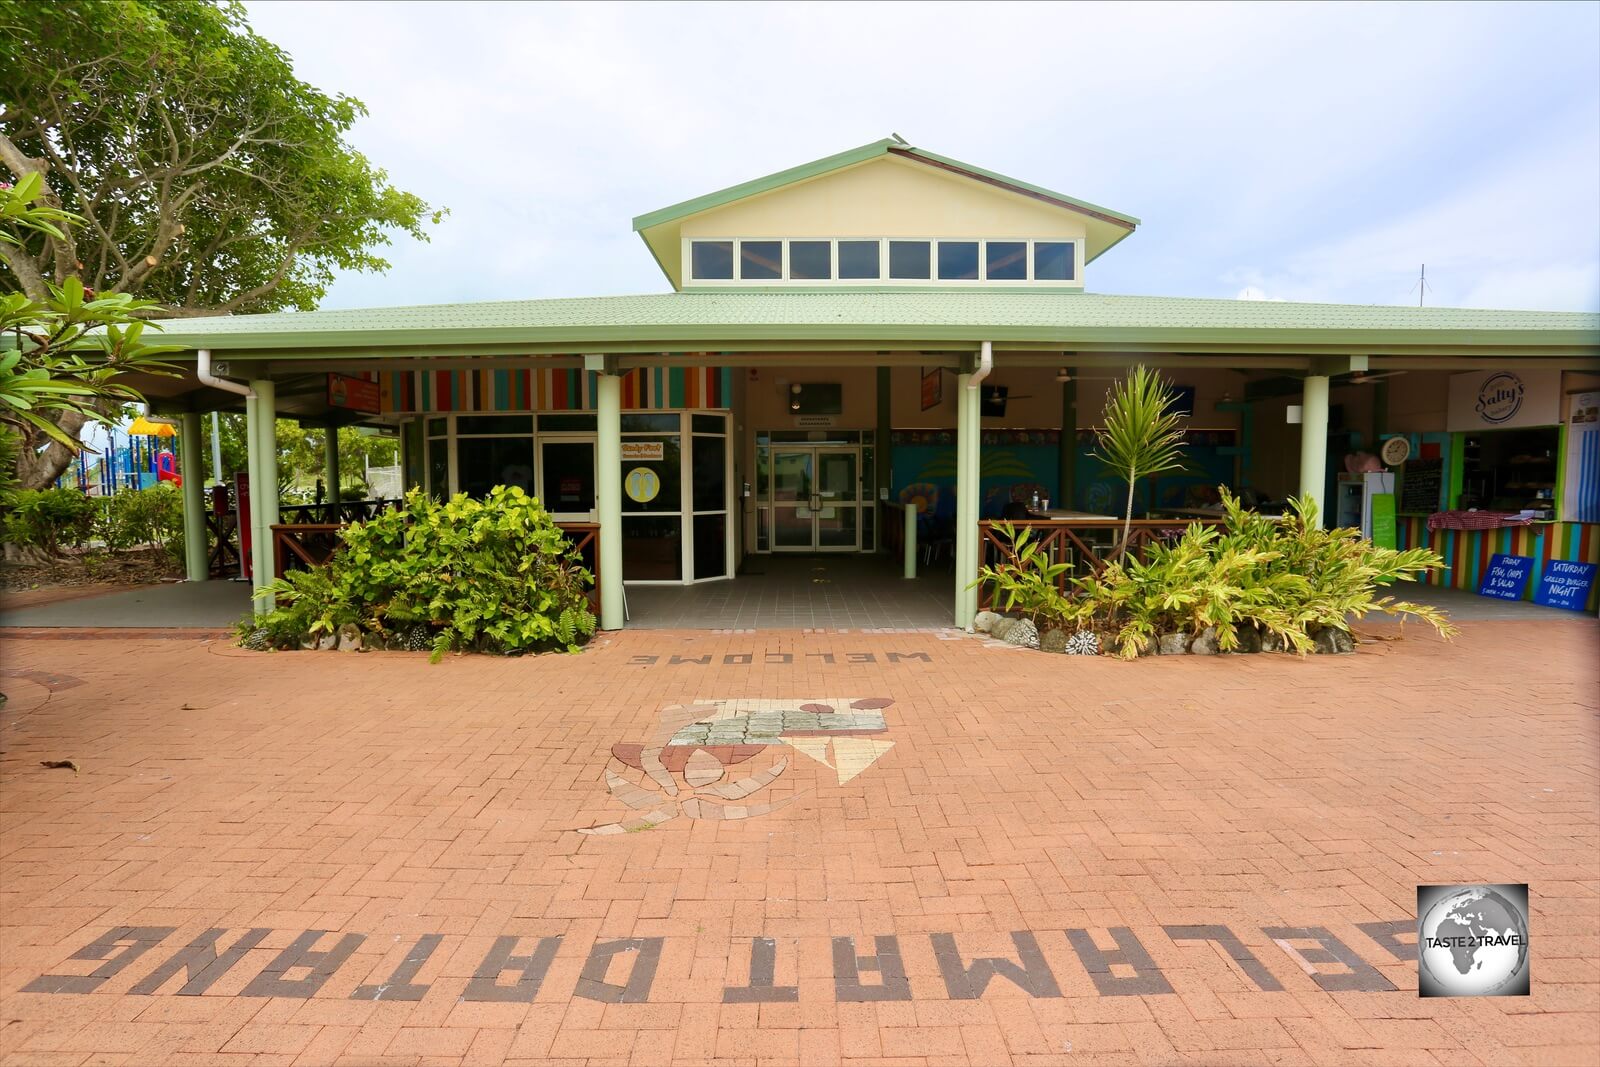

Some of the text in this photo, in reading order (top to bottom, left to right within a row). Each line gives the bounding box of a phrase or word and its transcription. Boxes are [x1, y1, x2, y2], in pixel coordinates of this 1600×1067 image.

[1475, 383, 1524, 412] Salty's
[1502, 557, 1521, 566] FRIDAY
[1506, 568, 1523, 580] CHIPS
[1553, 562, 1589, 575] SATURDAY
[1497, 577, 1515, 588] SALAD
[1565, 577, 1589, 588] BURGER
[1548, 583, 1580, 597] NIGHT
[626, 651, 933, 666] WELCOME
[17, 926, 666, 1003] DATANG
